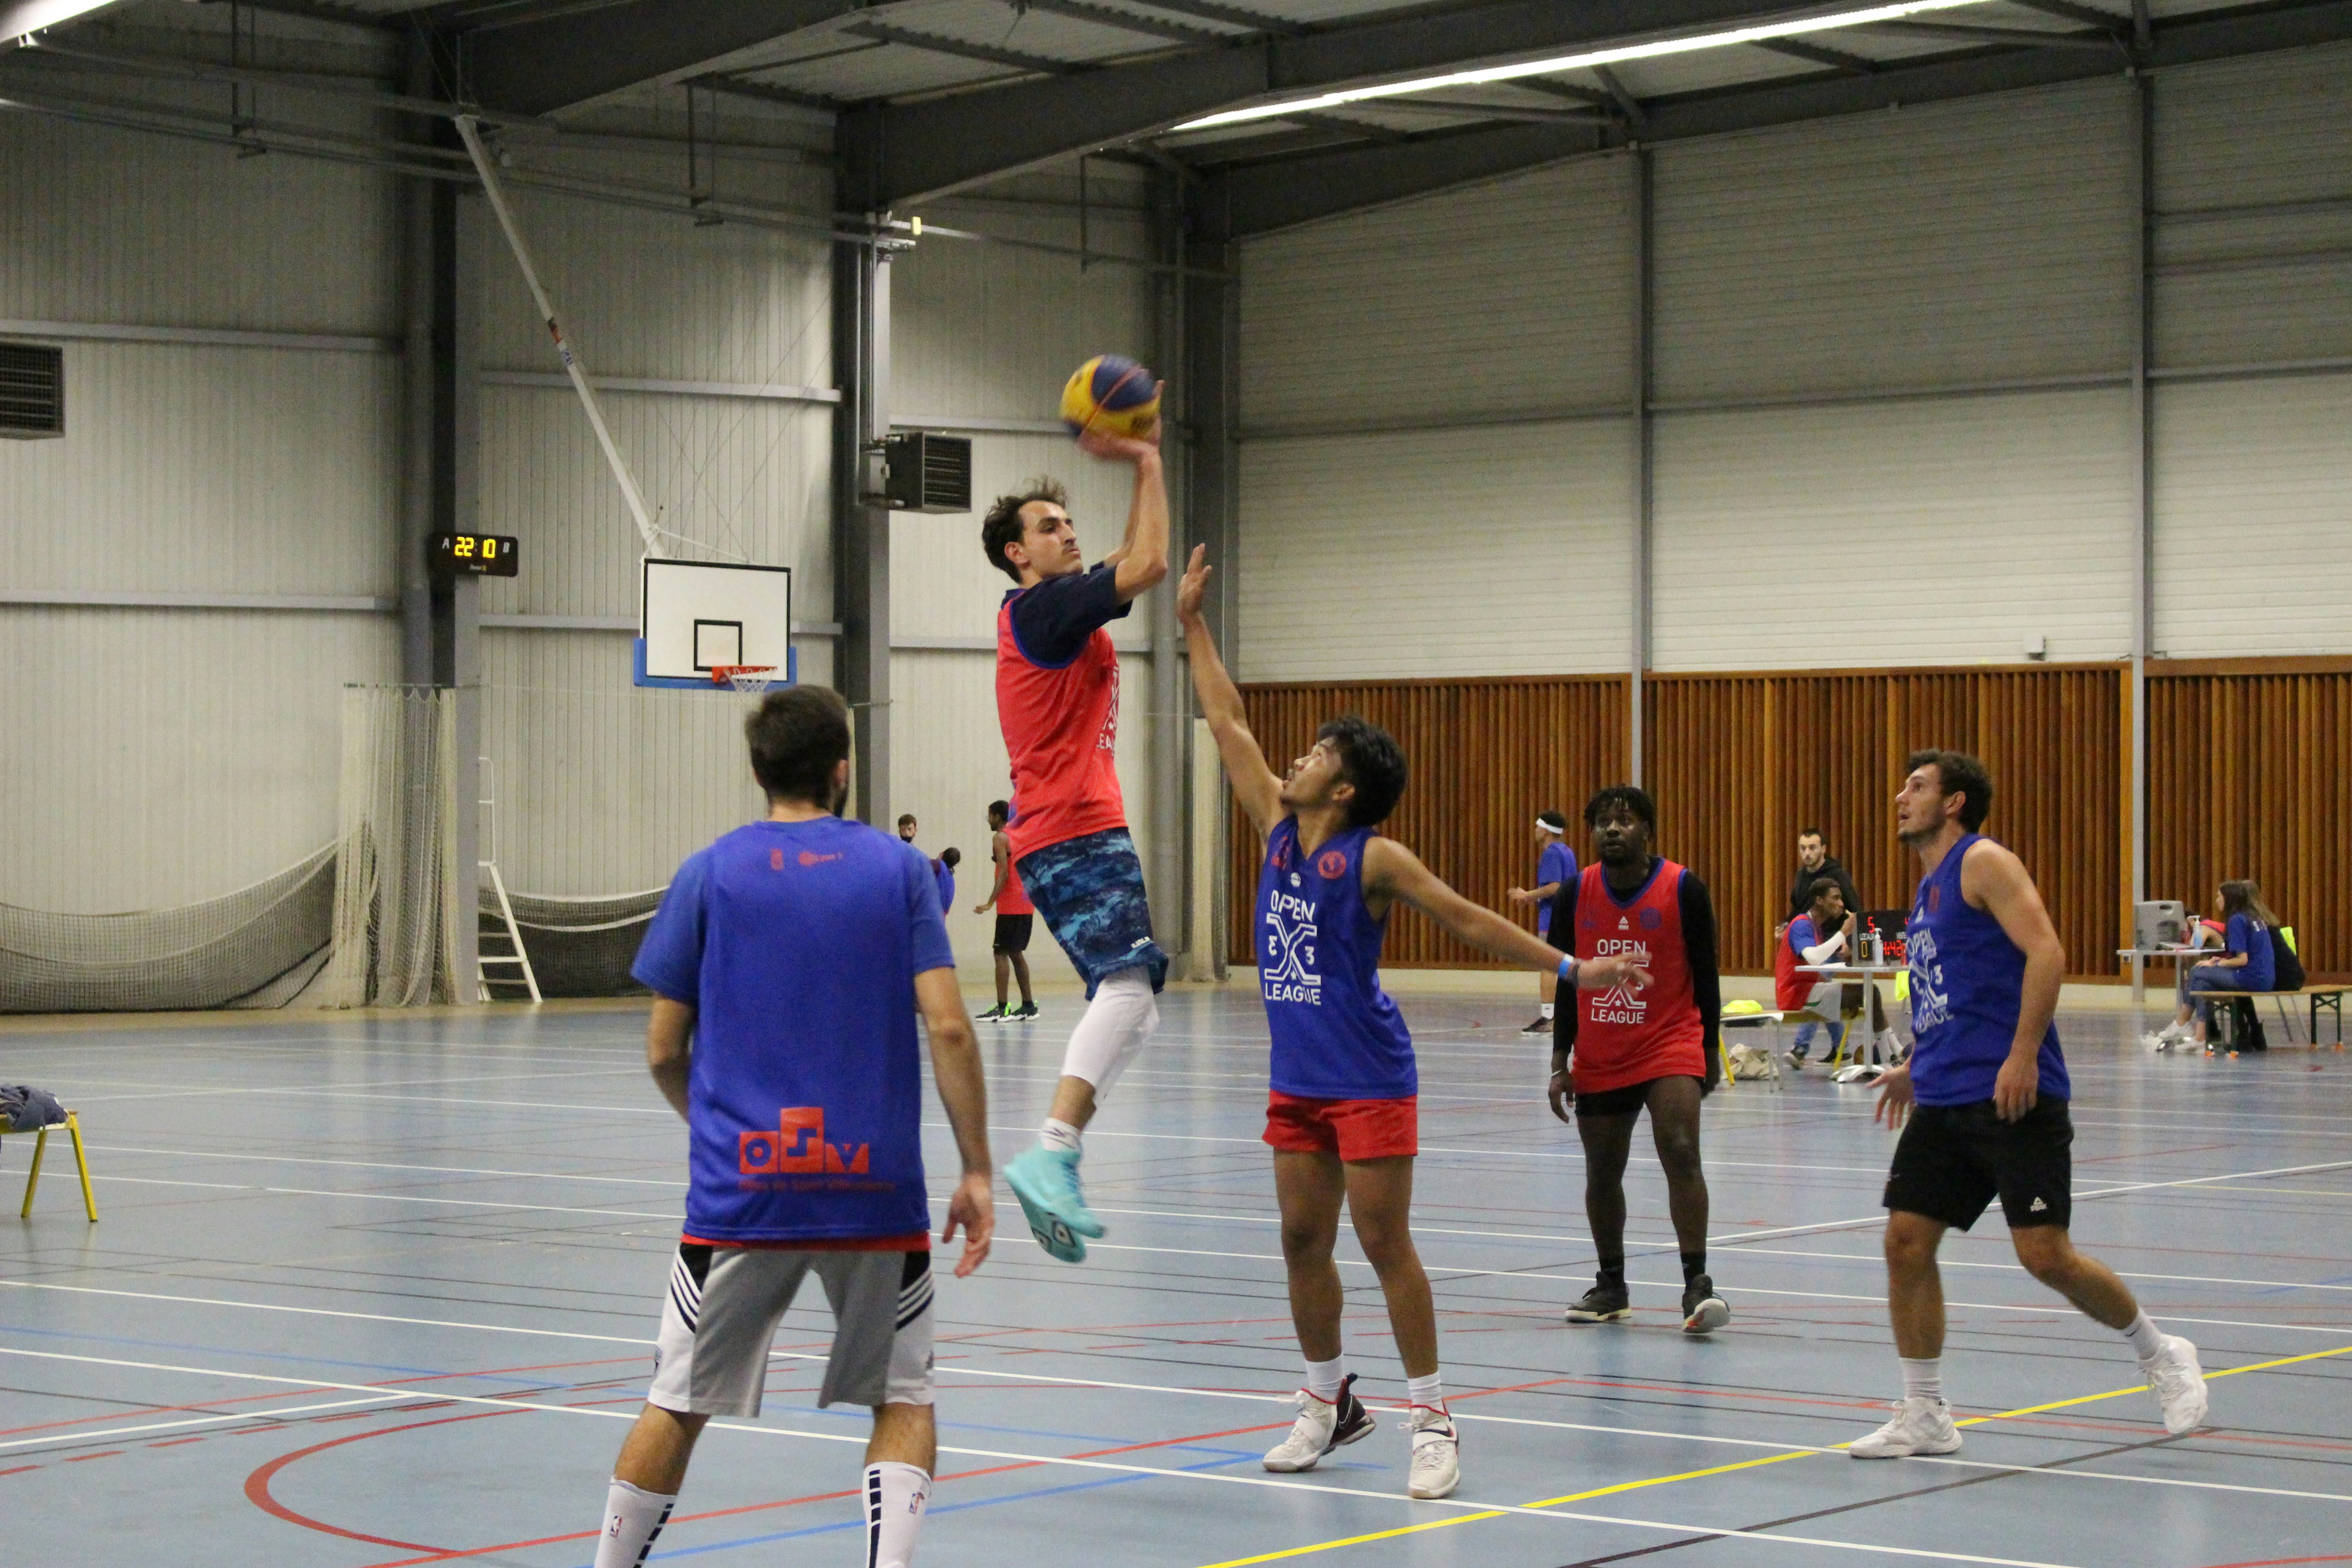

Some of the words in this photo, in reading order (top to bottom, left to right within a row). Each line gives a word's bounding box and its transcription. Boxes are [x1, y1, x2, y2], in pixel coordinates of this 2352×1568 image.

[442, 537, 450, 549] A
[455, 536, 474, 557] 22
[503, 542, 510, 554] B
[1271, 890, 1315, 922] OPEN
[1597, 939, 1646, 956] OPEN
[1265, 982, 1321, 1005] LEAGUE
[1591, 1008, 1645, 1024] LEAGUE
